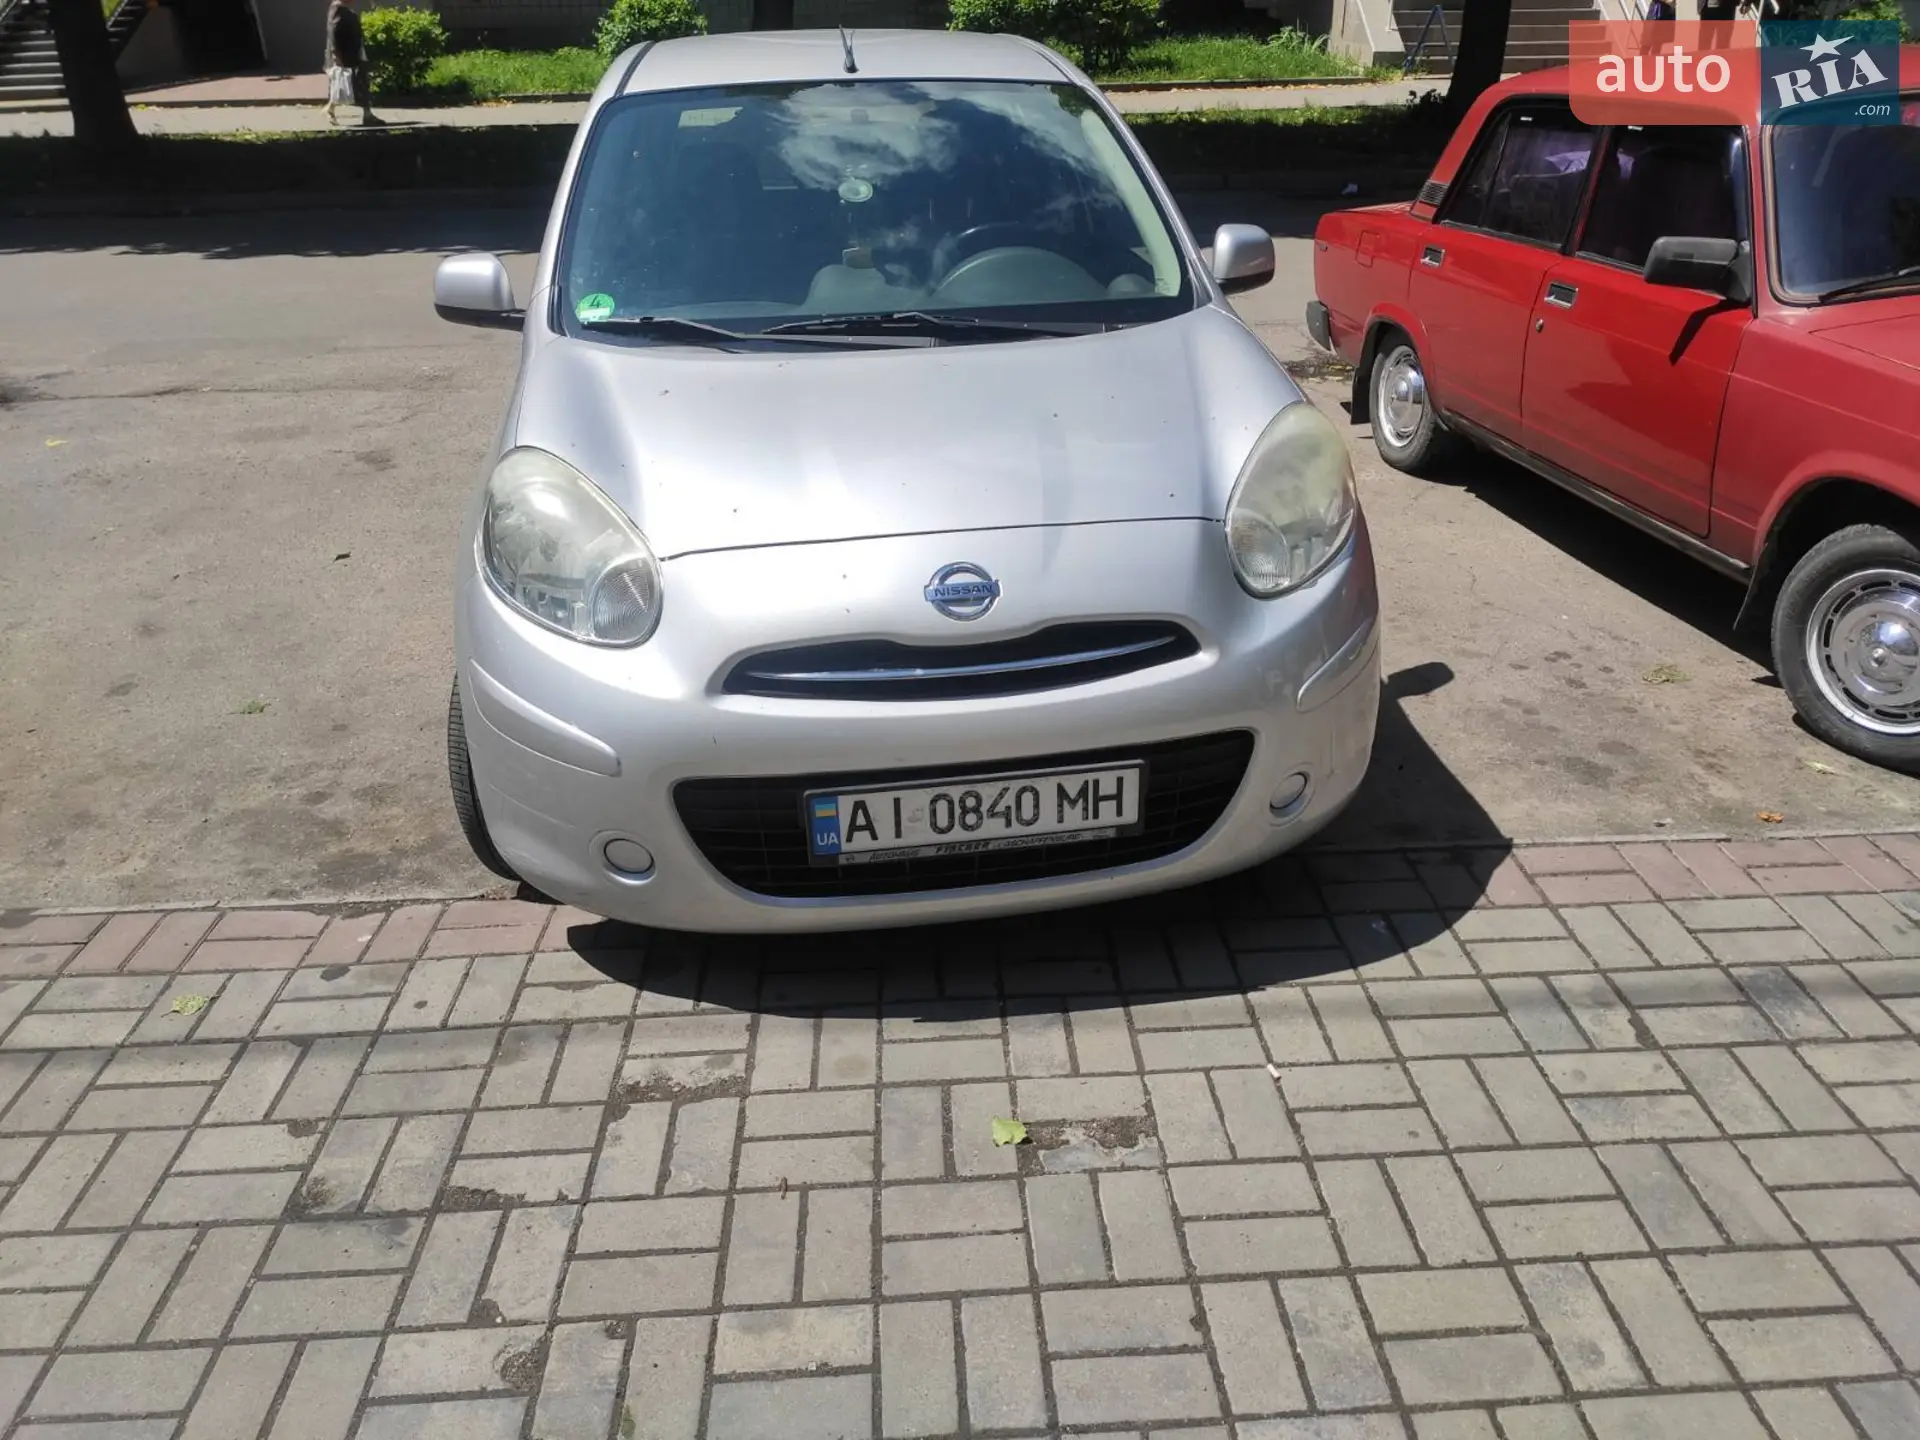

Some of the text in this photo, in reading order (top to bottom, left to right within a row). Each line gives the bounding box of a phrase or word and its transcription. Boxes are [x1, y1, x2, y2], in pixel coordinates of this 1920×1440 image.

[588, 294, 602, 308] 4
[934, 584, 993, 597] NISSAN
[929, 786, 1040, 835] 0840
[1056, 776, 1125, 824] MH
[816, 831, 839, 847] UA
